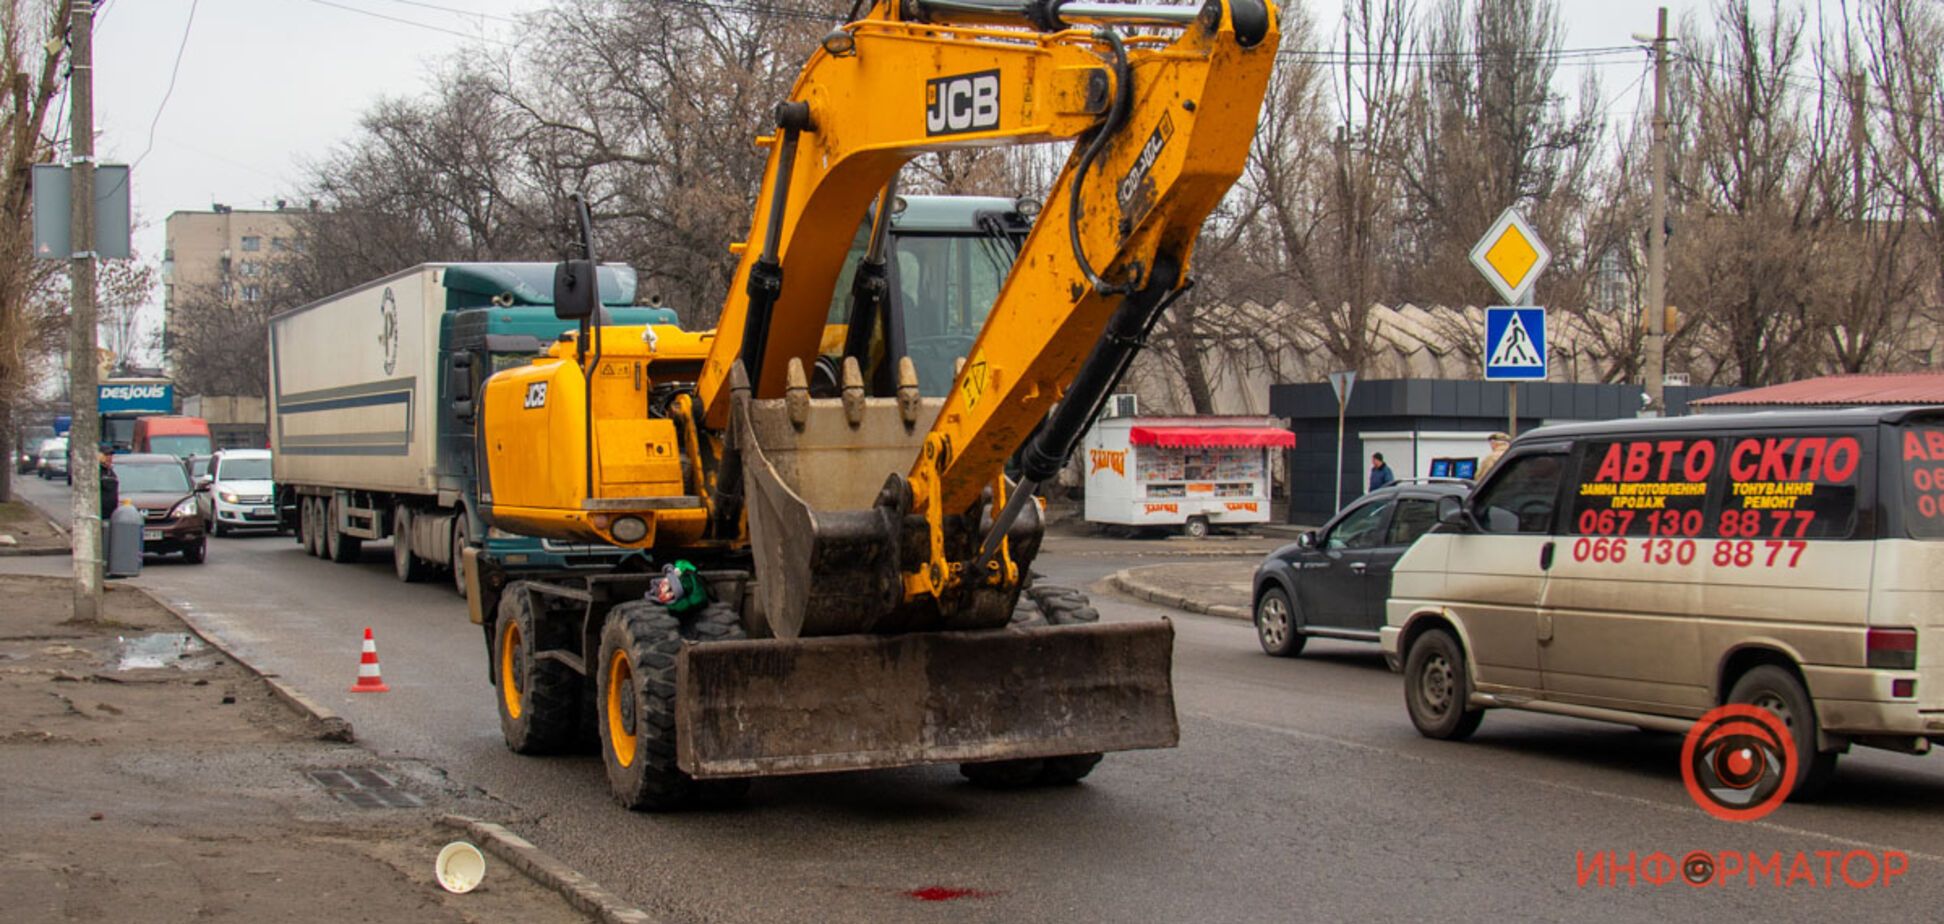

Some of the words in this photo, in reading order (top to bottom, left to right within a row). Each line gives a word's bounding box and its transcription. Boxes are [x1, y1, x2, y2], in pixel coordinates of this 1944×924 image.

[928, 76, 998, 132] JCB
[525, 383, 547, 407] JCB
[1595, 439, 1715, 482] АВТО
[1733, 482, 1814, 495] ТОНУВАННЯ
[1611, 496, 1665, 508] ПРОДАЖ
[1743, 496, 1797, 509] РЕМОНТ
[1579, 509, 1635, 536] 067
[1646, 510, 1703, 537] 130
[1718, 511, 1760, 538] 88
[1771, 511, 1815, 538] 77
[1573, 537, 1628, 564] 066
[1640, 539, 1697, 566] 130
[1712, 540, 1754, 567] 88
[1765, 540, 1807, 568] 77
